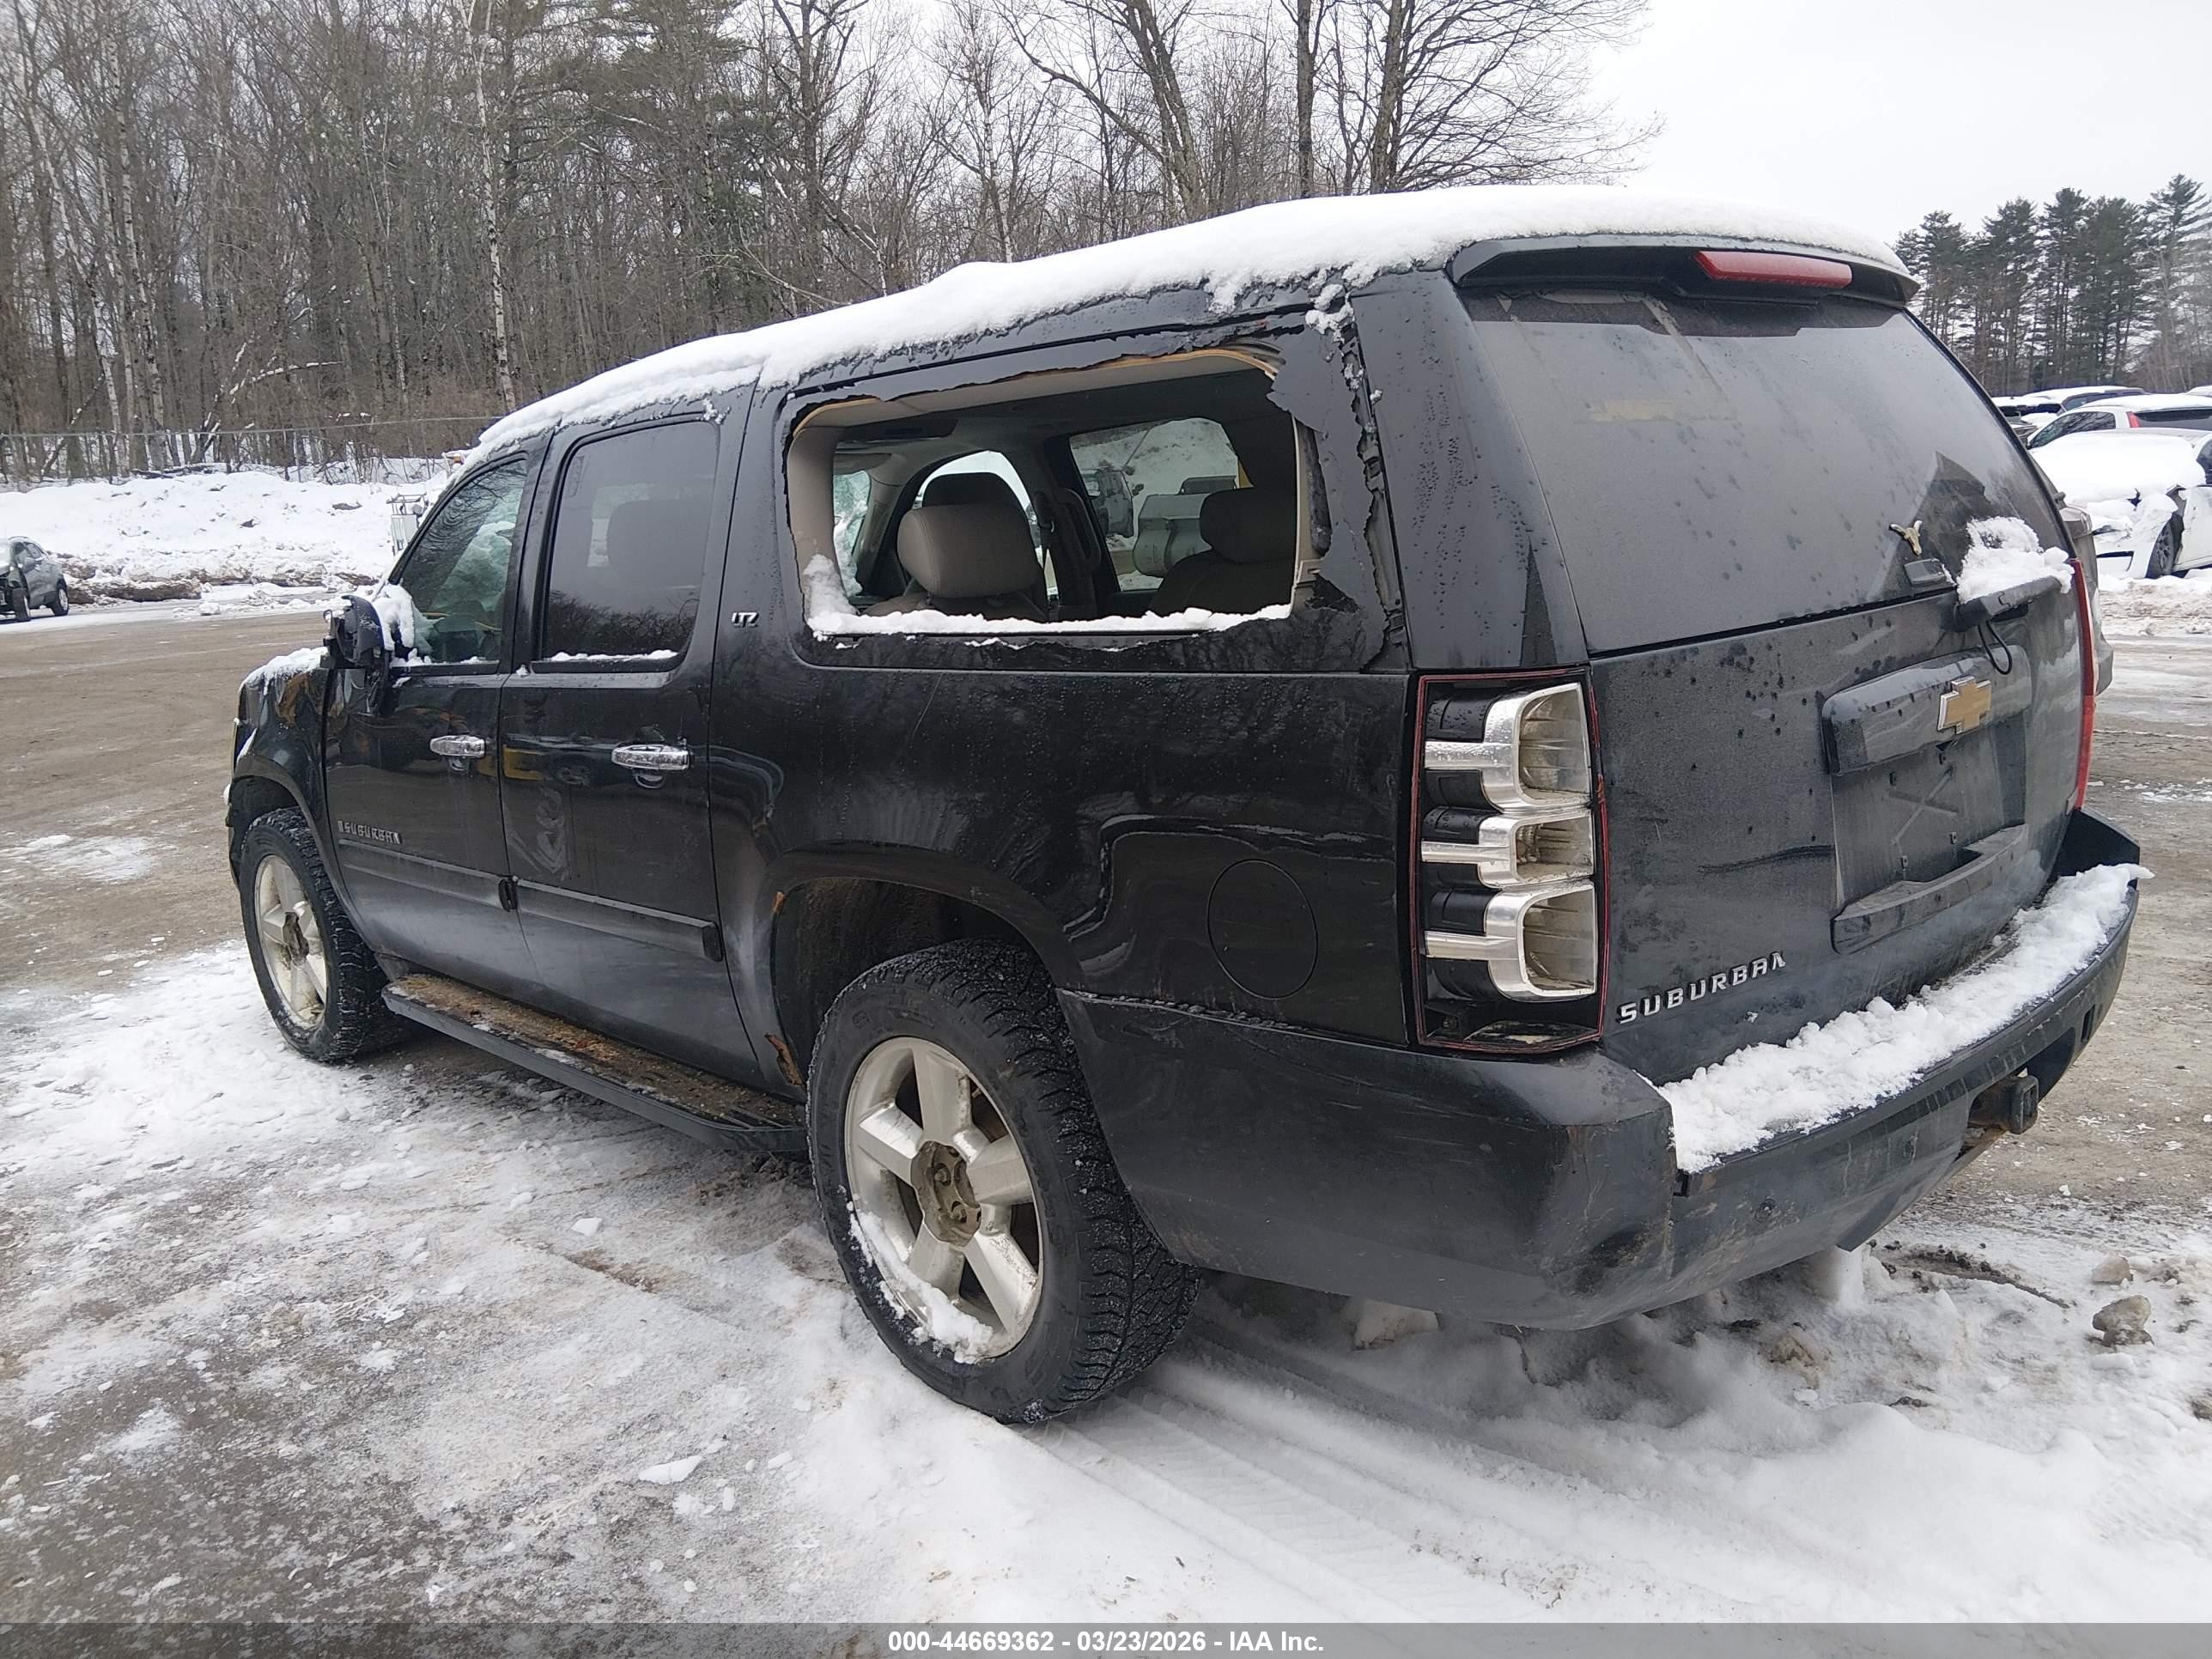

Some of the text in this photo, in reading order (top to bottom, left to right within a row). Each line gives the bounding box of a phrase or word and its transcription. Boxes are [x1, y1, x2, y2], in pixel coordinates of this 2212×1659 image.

[732, 611, 758, 627] LTZ
[343, 821, 402, 845] SUBURBAN
[1616, 951, 1786, 1024] SUBURBAN
